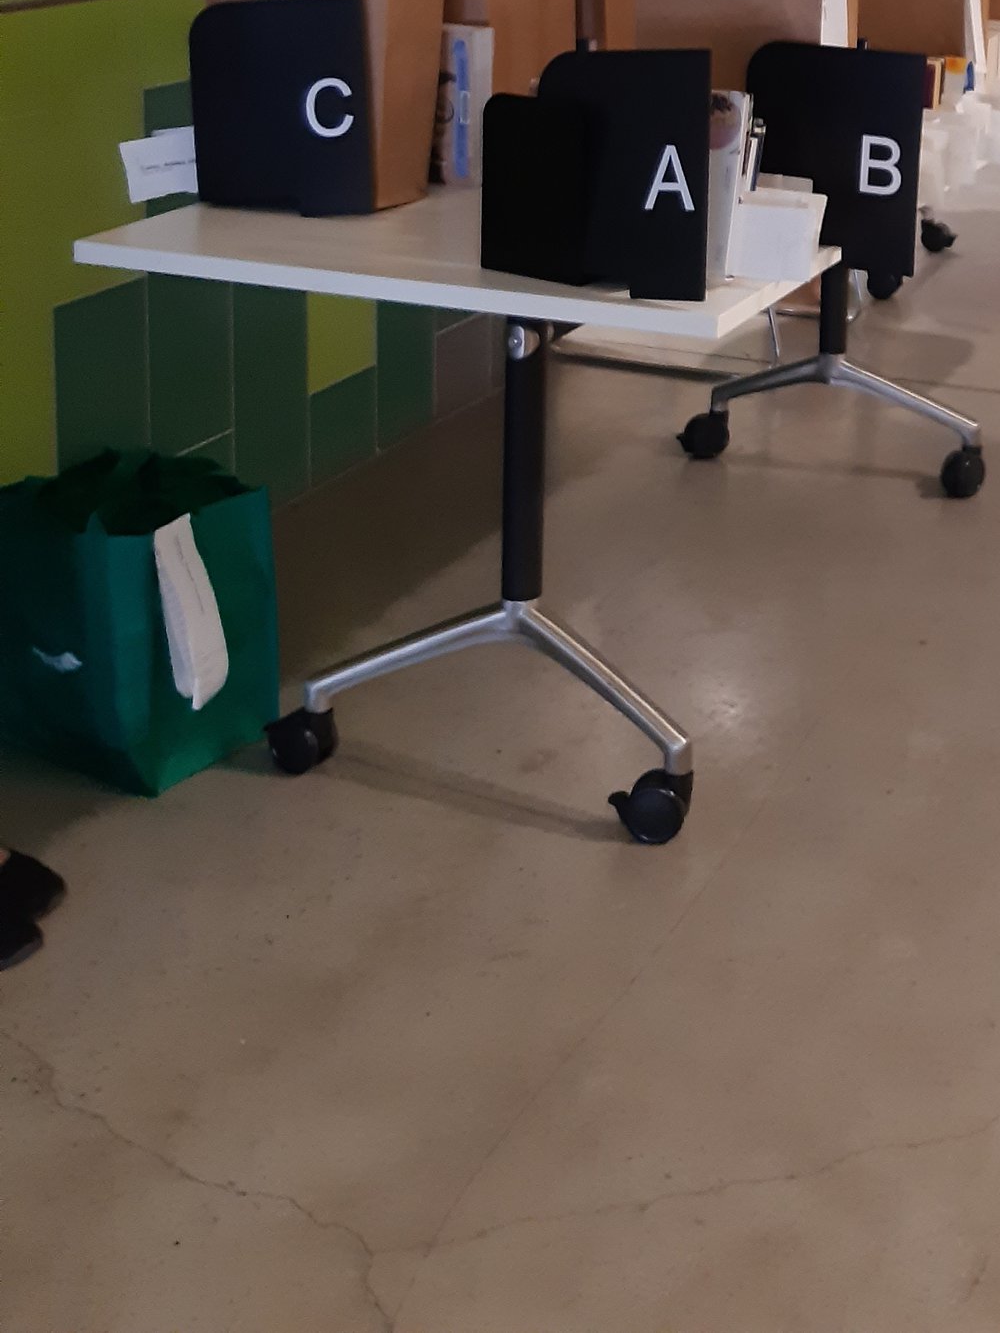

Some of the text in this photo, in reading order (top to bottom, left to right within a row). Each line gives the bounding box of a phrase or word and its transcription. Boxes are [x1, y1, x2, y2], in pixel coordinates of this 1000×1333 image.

[304, 77, 354, 138] C
[643, 144, 695, 212] A
[858, 134, 902, 196] B
